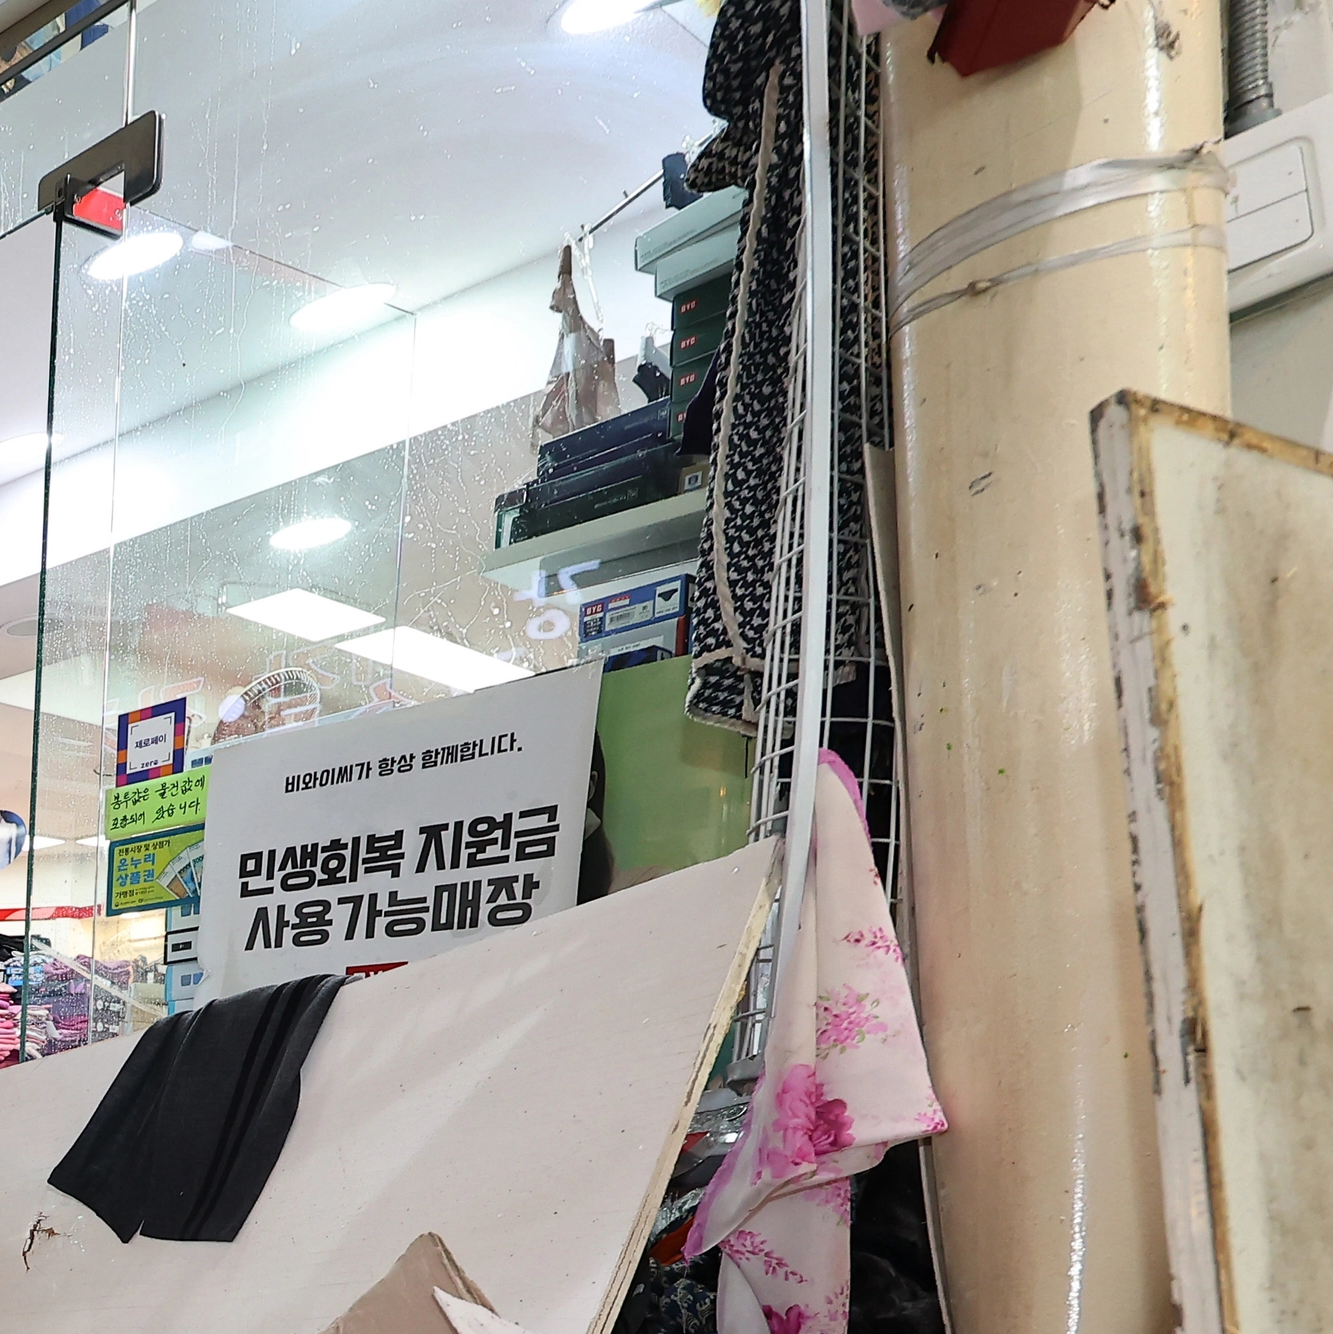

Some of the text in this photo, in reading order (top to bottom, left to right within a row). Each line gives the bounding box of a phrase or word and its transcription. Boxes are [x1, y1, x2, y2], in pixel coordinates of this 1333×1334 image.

[585, 603, 603, 615] BYC
[134, 733, 167, 748] 제로페이
[140, 759, 158, 768] zero
[284, 731, 523, 793] 비와이씨가 항상 함께합니다.
[111, 788, 150, 810] 봉투값은
[238, 804, 560, 898] 민생회복 지원금
[117, 852, 156, 872] 온누리
[116, 868, 155, 887] 상품권
[244, 873, 540, 951] 사용가능매장
